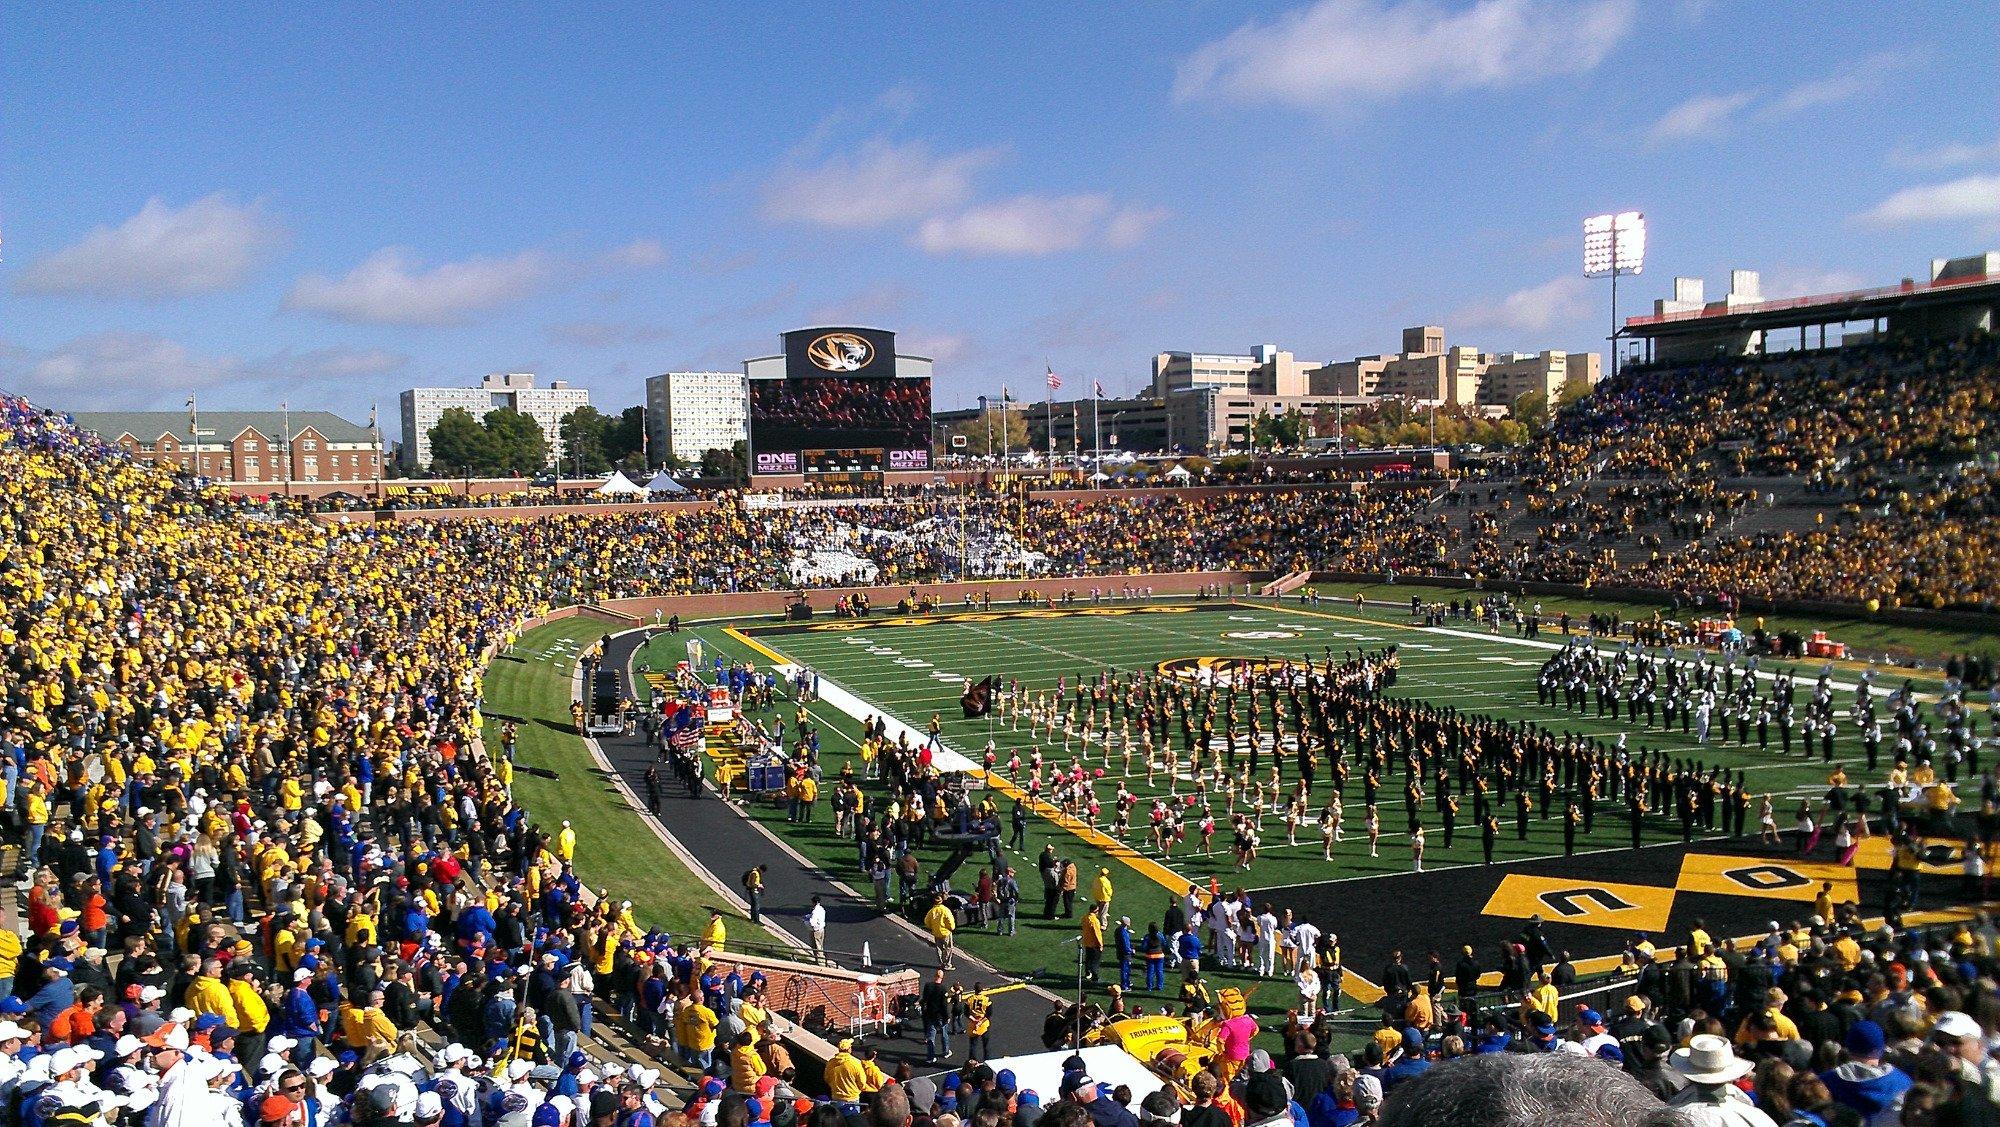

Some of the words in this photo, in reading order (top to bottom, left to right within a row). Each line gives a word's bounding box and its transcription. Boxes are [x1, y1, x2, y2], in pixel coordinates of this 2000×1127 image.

[757, 453, 797, 463] ONE
[889, 450, 928, 460] ONE
[1129, 1026, 1163, 1039] TRUMAN'S
